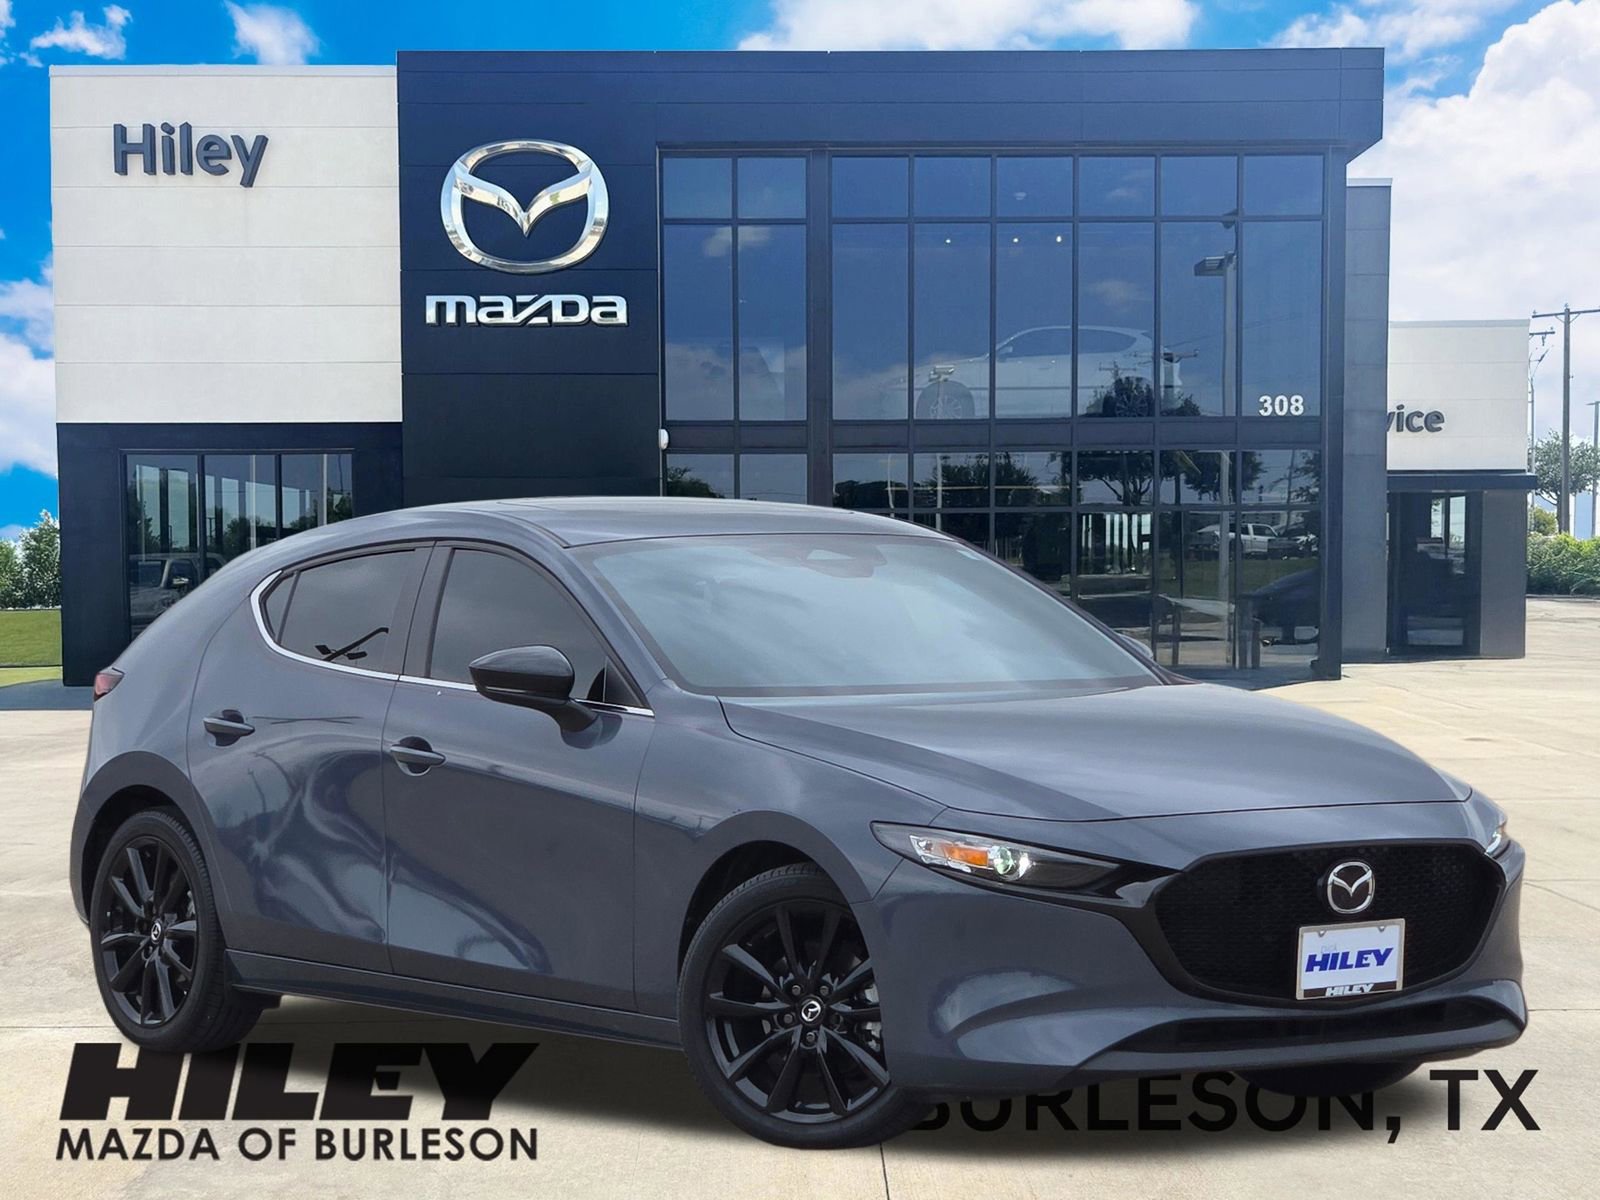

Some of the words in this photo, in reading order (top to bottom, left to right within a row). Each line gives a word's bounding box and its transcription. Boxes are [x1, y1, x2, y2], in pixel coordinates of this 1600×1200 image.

[113, 121, 269, 188] Hiley
[1258, 395, 1305, 416] 308
[1305, 947, 1394, 973] HILEY
[1325, 983, 1375, 997] HILEY
